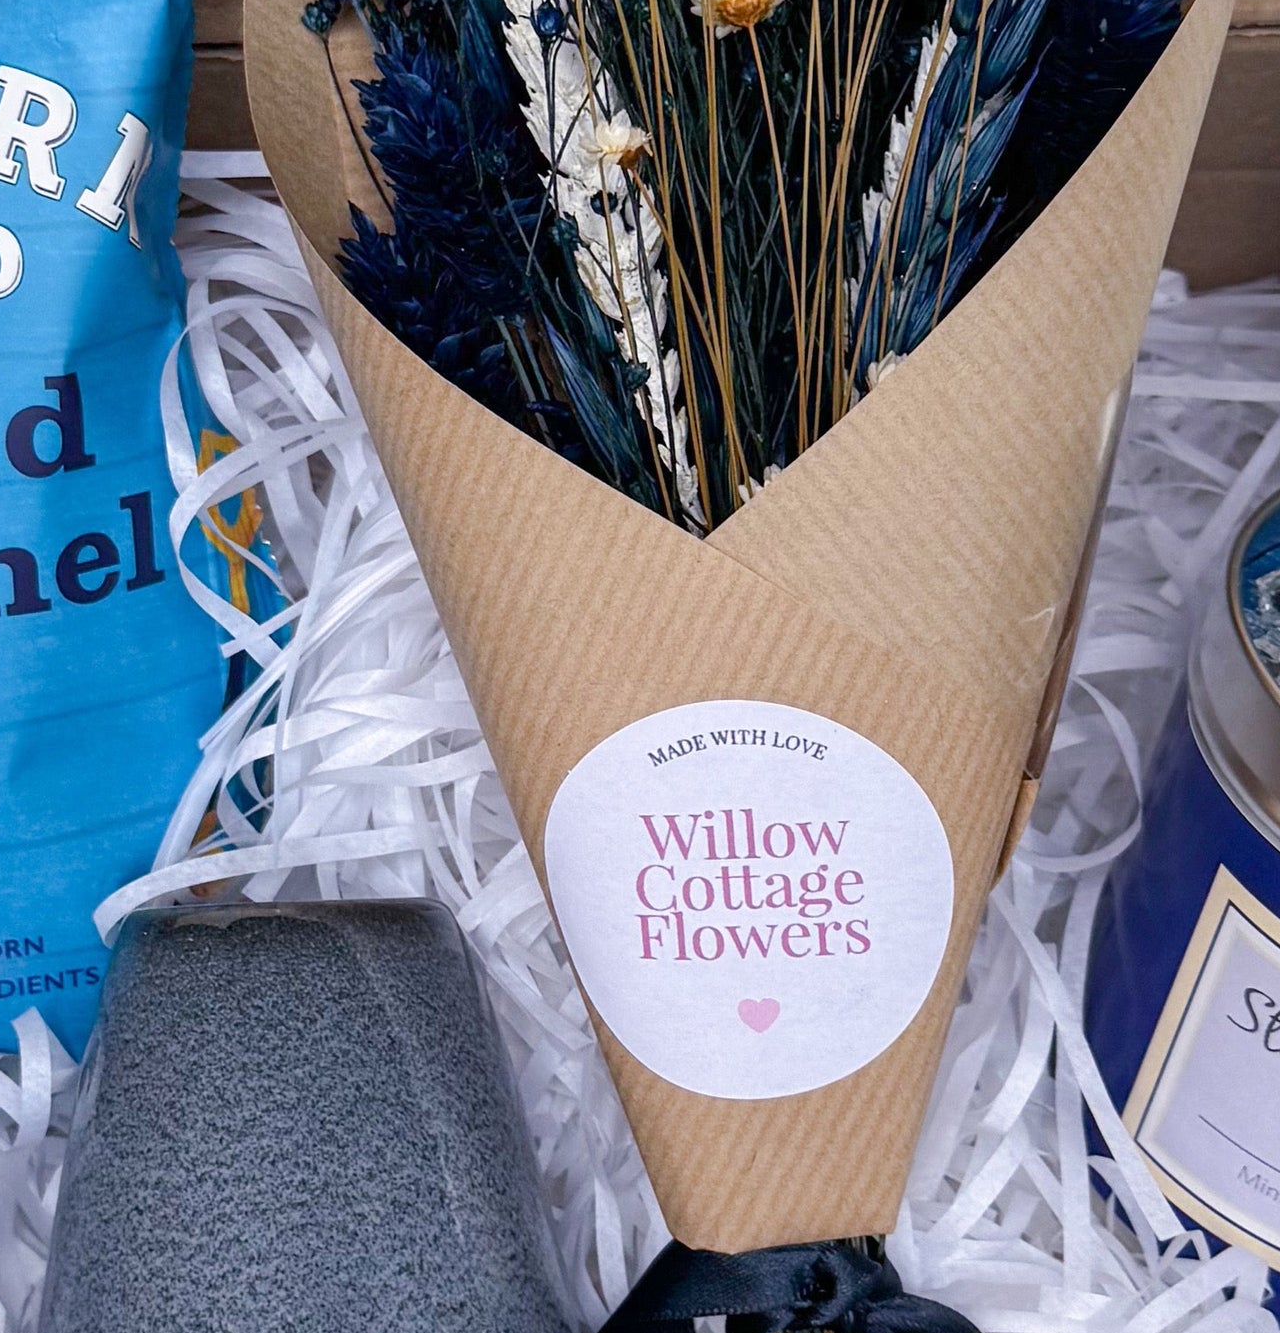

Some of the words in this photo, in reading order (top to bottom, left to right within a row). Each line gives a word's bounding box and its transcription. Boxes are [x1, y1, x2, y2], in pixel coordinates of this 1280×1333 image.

[647, 734, 707, 768] MADE
[710, 729, 767, 746] WITH
[772, 731, 828, 761] LOVE
[639, 808, 850, 862] Willow
[635, 863, 865, 918] Cottage
[635, 911, 872, 962] Flowers
